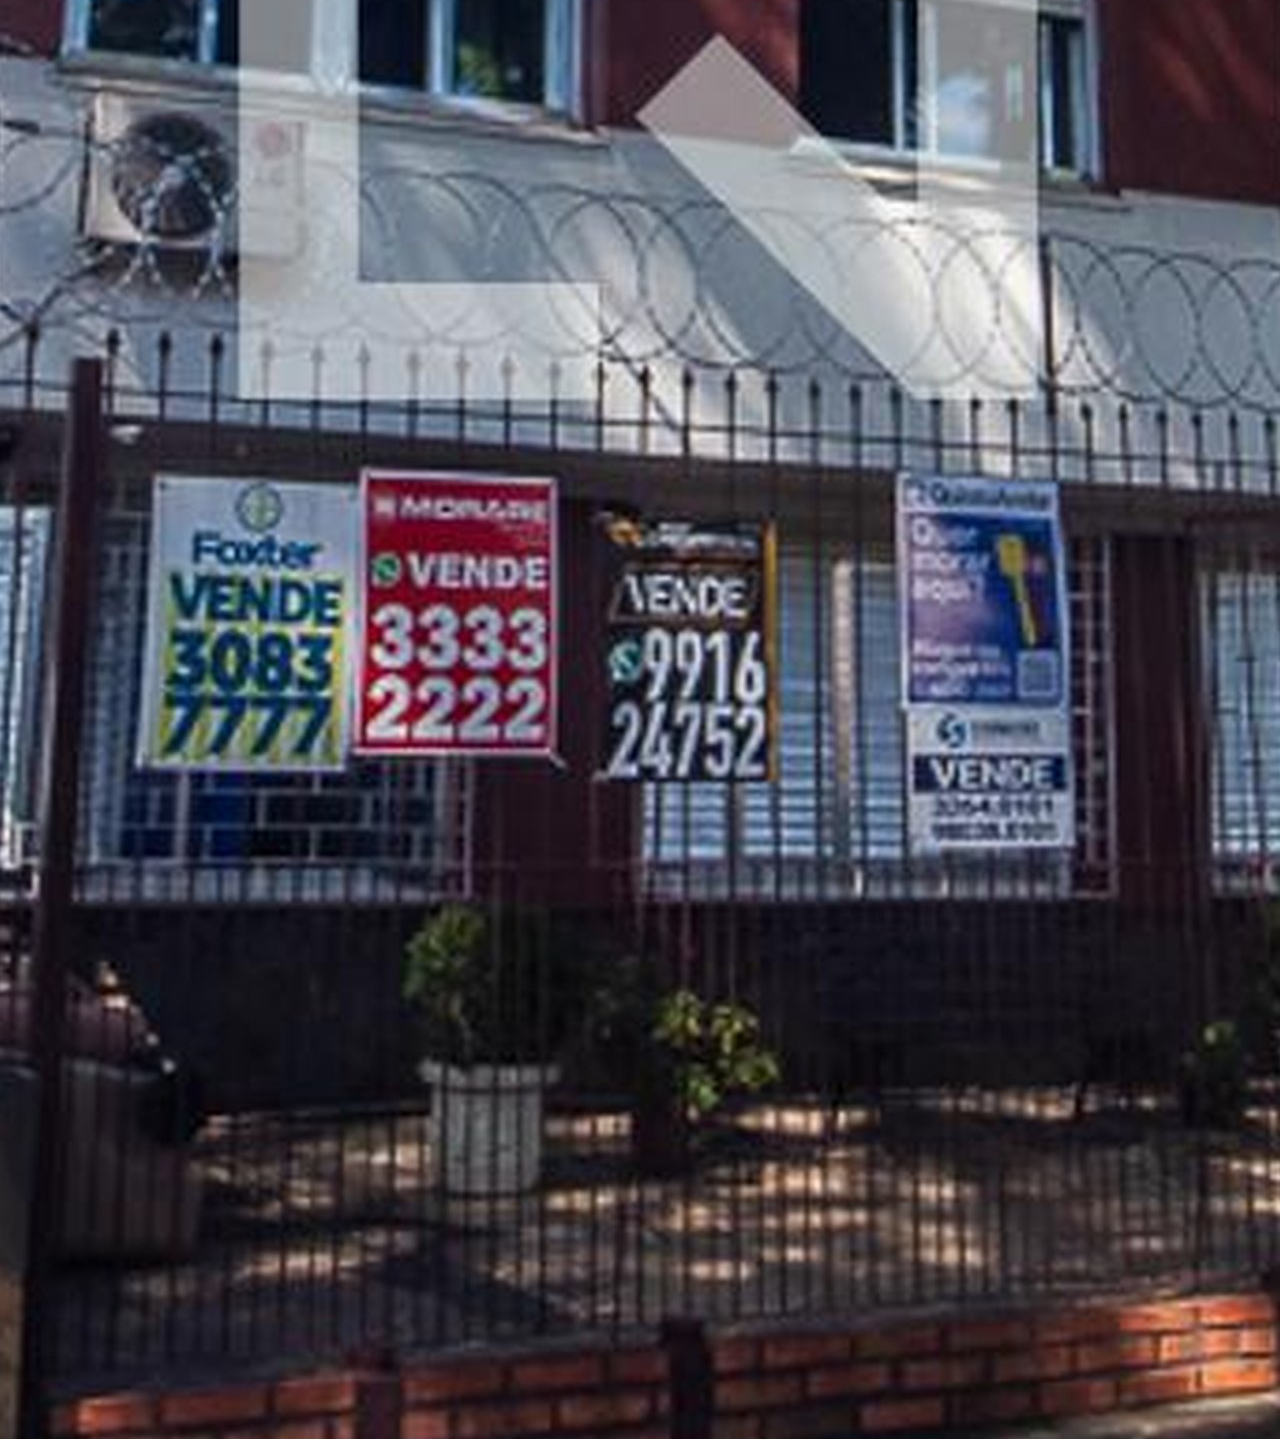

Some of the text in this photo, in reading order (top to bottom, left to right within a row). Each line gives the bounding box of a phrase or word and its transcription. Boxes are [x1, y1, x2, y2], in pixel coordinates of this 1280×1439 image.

[193, 529, 322, 566] Foxter
[407, 552, 547, 590] VENDE
[171, 572, 344, 626] VENDE
[625, 574, 748, 618] VENDE
[169, 626, 333, 695] 3083
[371, 602, 547, 670] 3333
[644, 627, 766, 705] 9916
[164, 692, 333, 756] 7777
[365, 673, 546, 742] 2222
[607, 702, 766, 779] 24752
[929, 756, 1054, 790] VENDE
